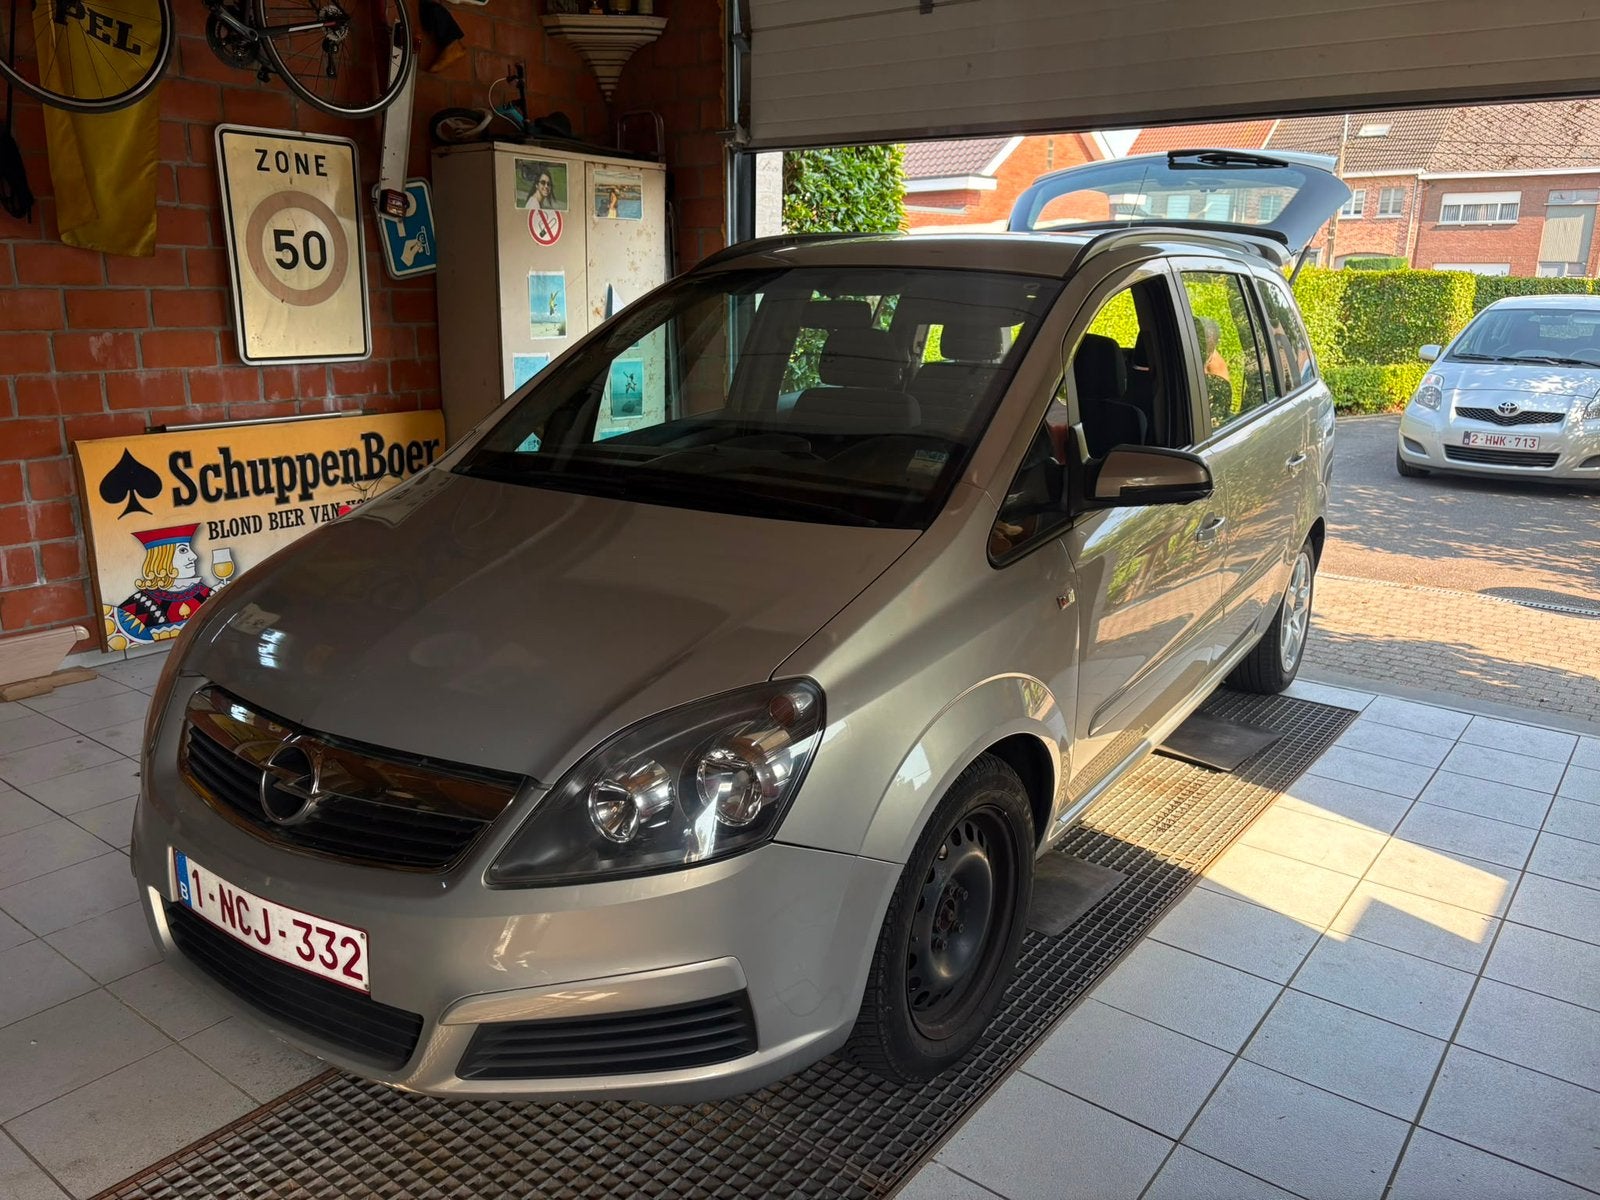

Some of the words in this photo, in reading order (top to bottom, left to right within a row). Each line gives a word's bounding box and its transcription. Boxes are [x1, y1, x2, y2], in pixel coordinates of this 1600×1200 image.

[255, 149, 327, 177] ZONE
[273, 229, 327, 270] 50
[169, 432, 439, 507] SchuppenBoer
[207, 515, 263, 540] BLOND
[268, 508, 305, 531] BIER
[310, 502, 341, 523] VAN
[180, 881, 189, 900] B
[192, 869, 363, 981] 1-NCJ-332
